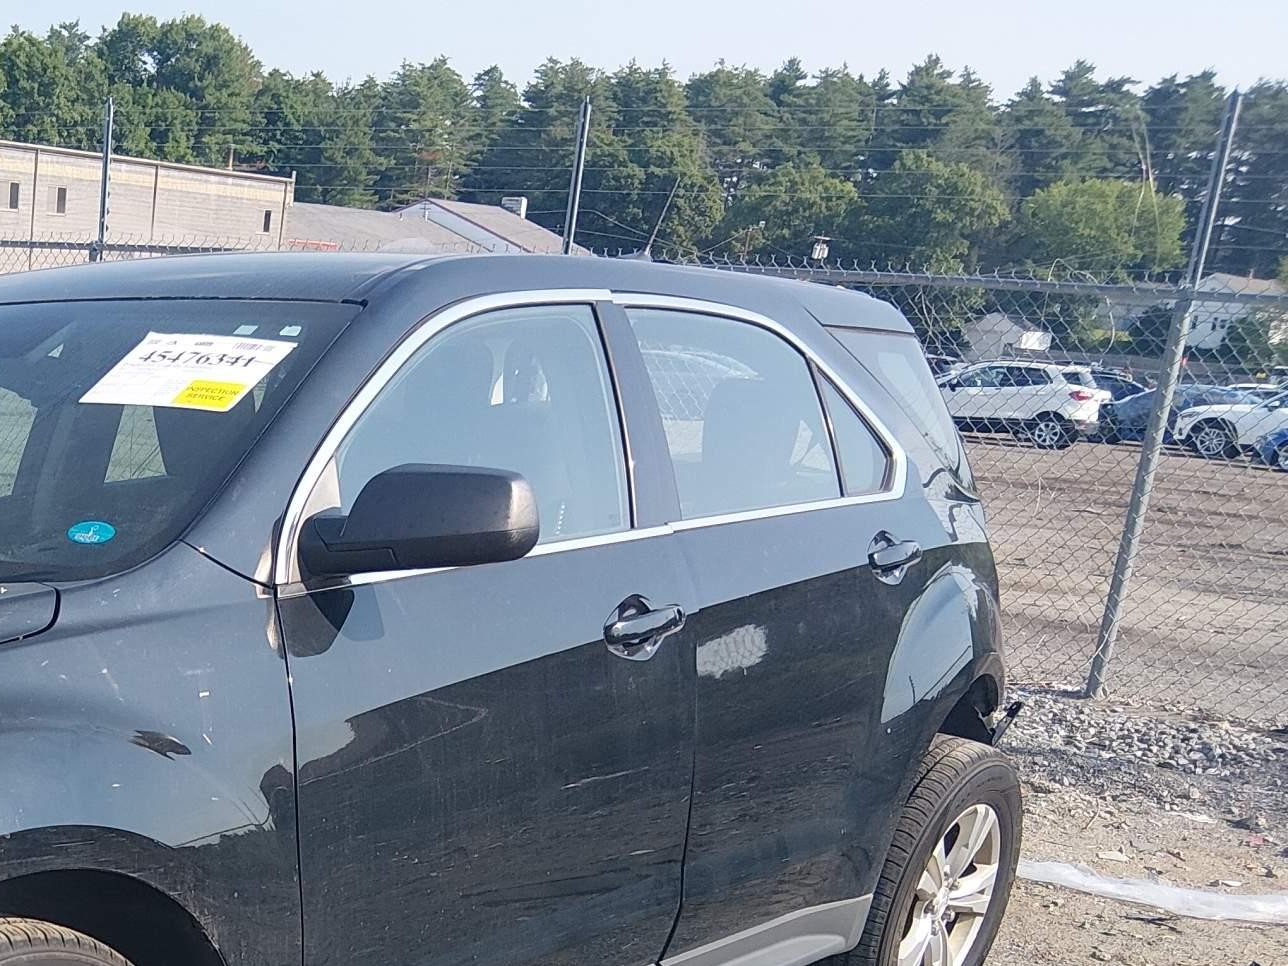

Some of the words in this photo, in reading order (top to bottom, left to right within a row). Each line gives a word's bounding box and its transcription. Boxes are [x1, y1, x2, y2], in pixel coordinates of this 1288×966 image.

[140, 350, 257, 367] 45476341
[187, 384, 240, 396] INSPECTION
[187, 392, 226, 402] SERVICE
